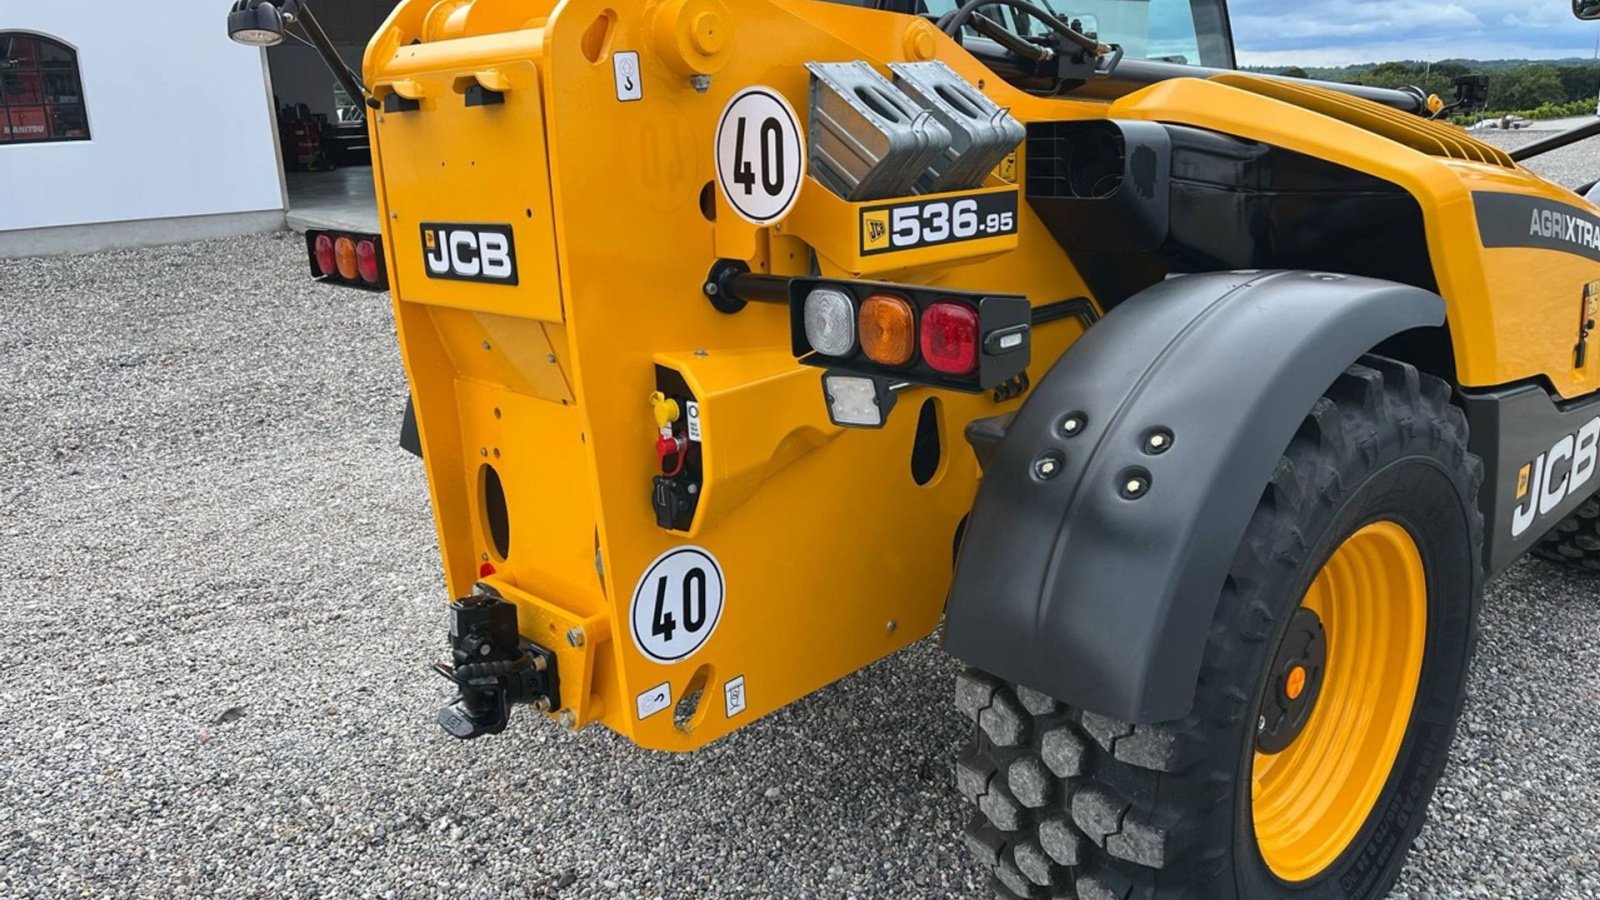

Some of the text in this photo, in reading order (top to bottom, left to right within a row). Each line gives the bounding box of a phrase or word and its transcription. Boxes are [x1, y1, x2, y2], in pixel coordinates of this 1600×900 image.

[4, 125, 45, 134] MANITOU
[734, 117, 784, 196] 40
[427, 229, 512, 279] JCB
[866, 219, 886, 241] JCB
[1529, 208, 1600, 252] AGRIXTRA
[1511, 416, 1600, 537] JCB
[652, 567, 706, 642] 40
